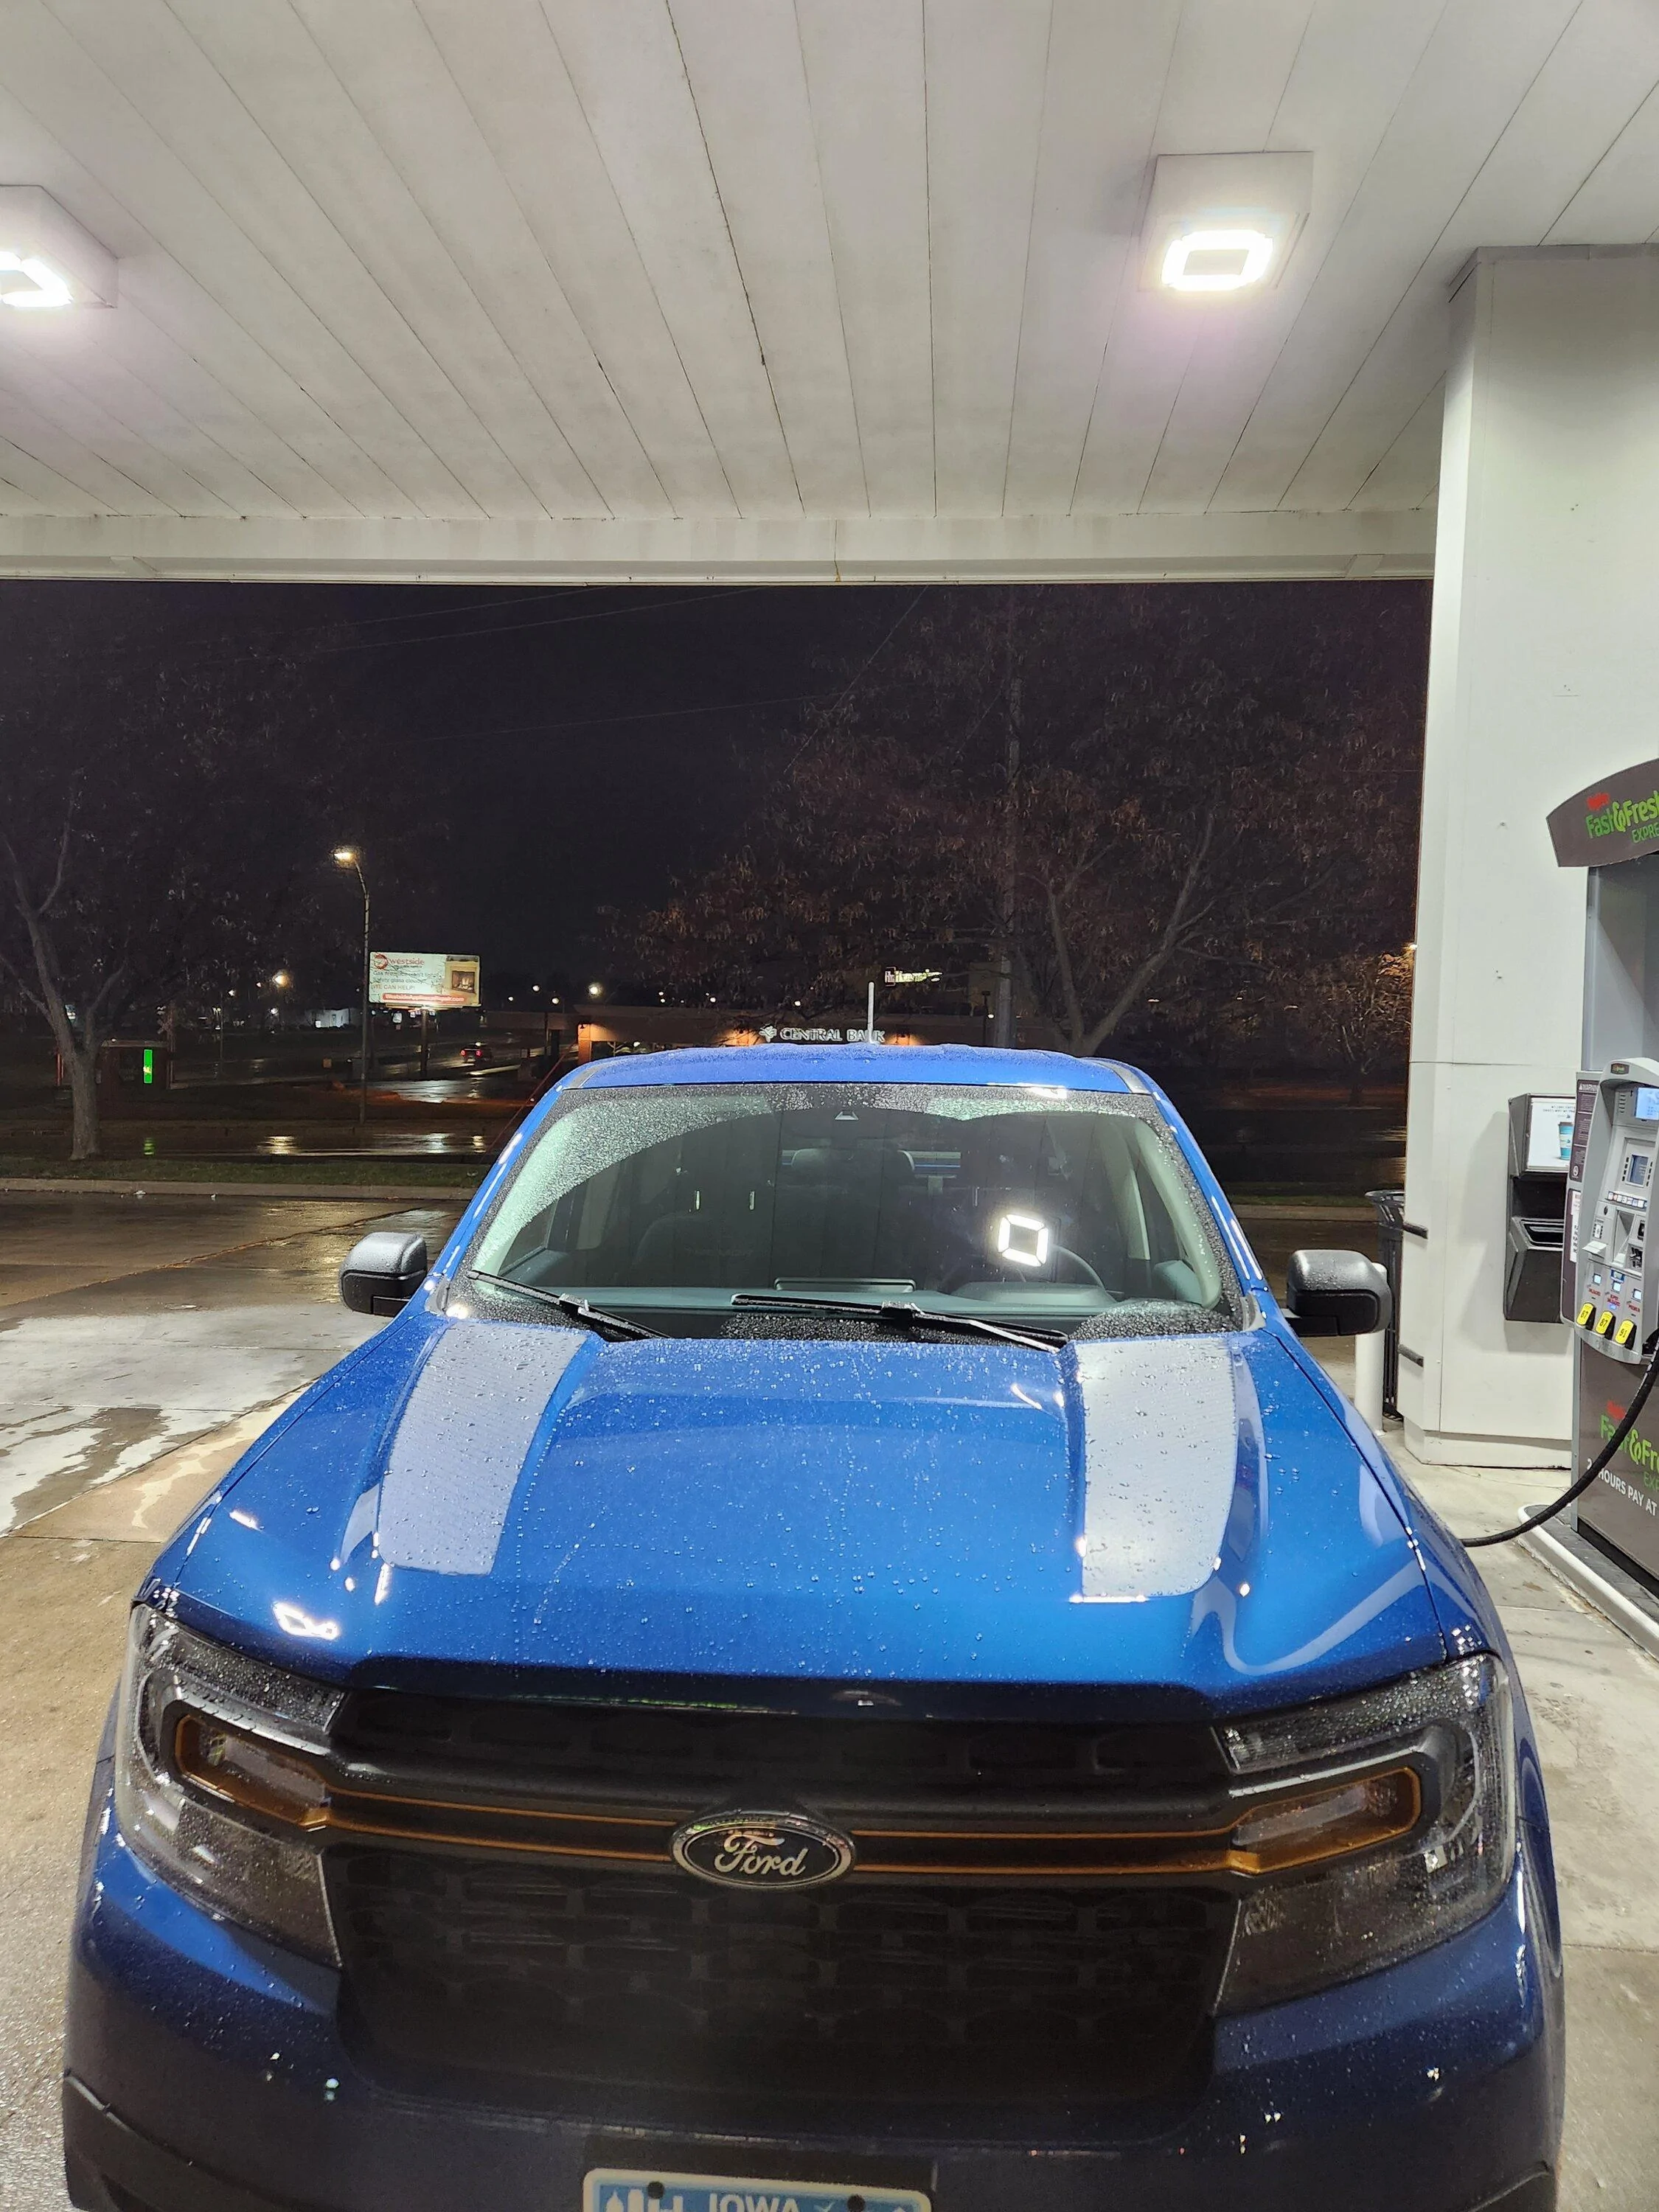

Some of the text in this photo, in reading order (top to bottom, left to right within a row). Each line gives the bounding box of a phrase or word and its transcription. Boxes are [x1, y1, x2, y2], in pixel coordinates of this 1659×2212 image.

[780, 1027, 843, 1041] CENTRAL
[1599, 1318, 1608, 1327] 87
[1619, 1328, 1627, 1338] 91
[1628, 1485, 1644, 1506] PAY
[1645, 1498, 1658, 1516] AT
[714, 1834, 808, 1876] Ford
